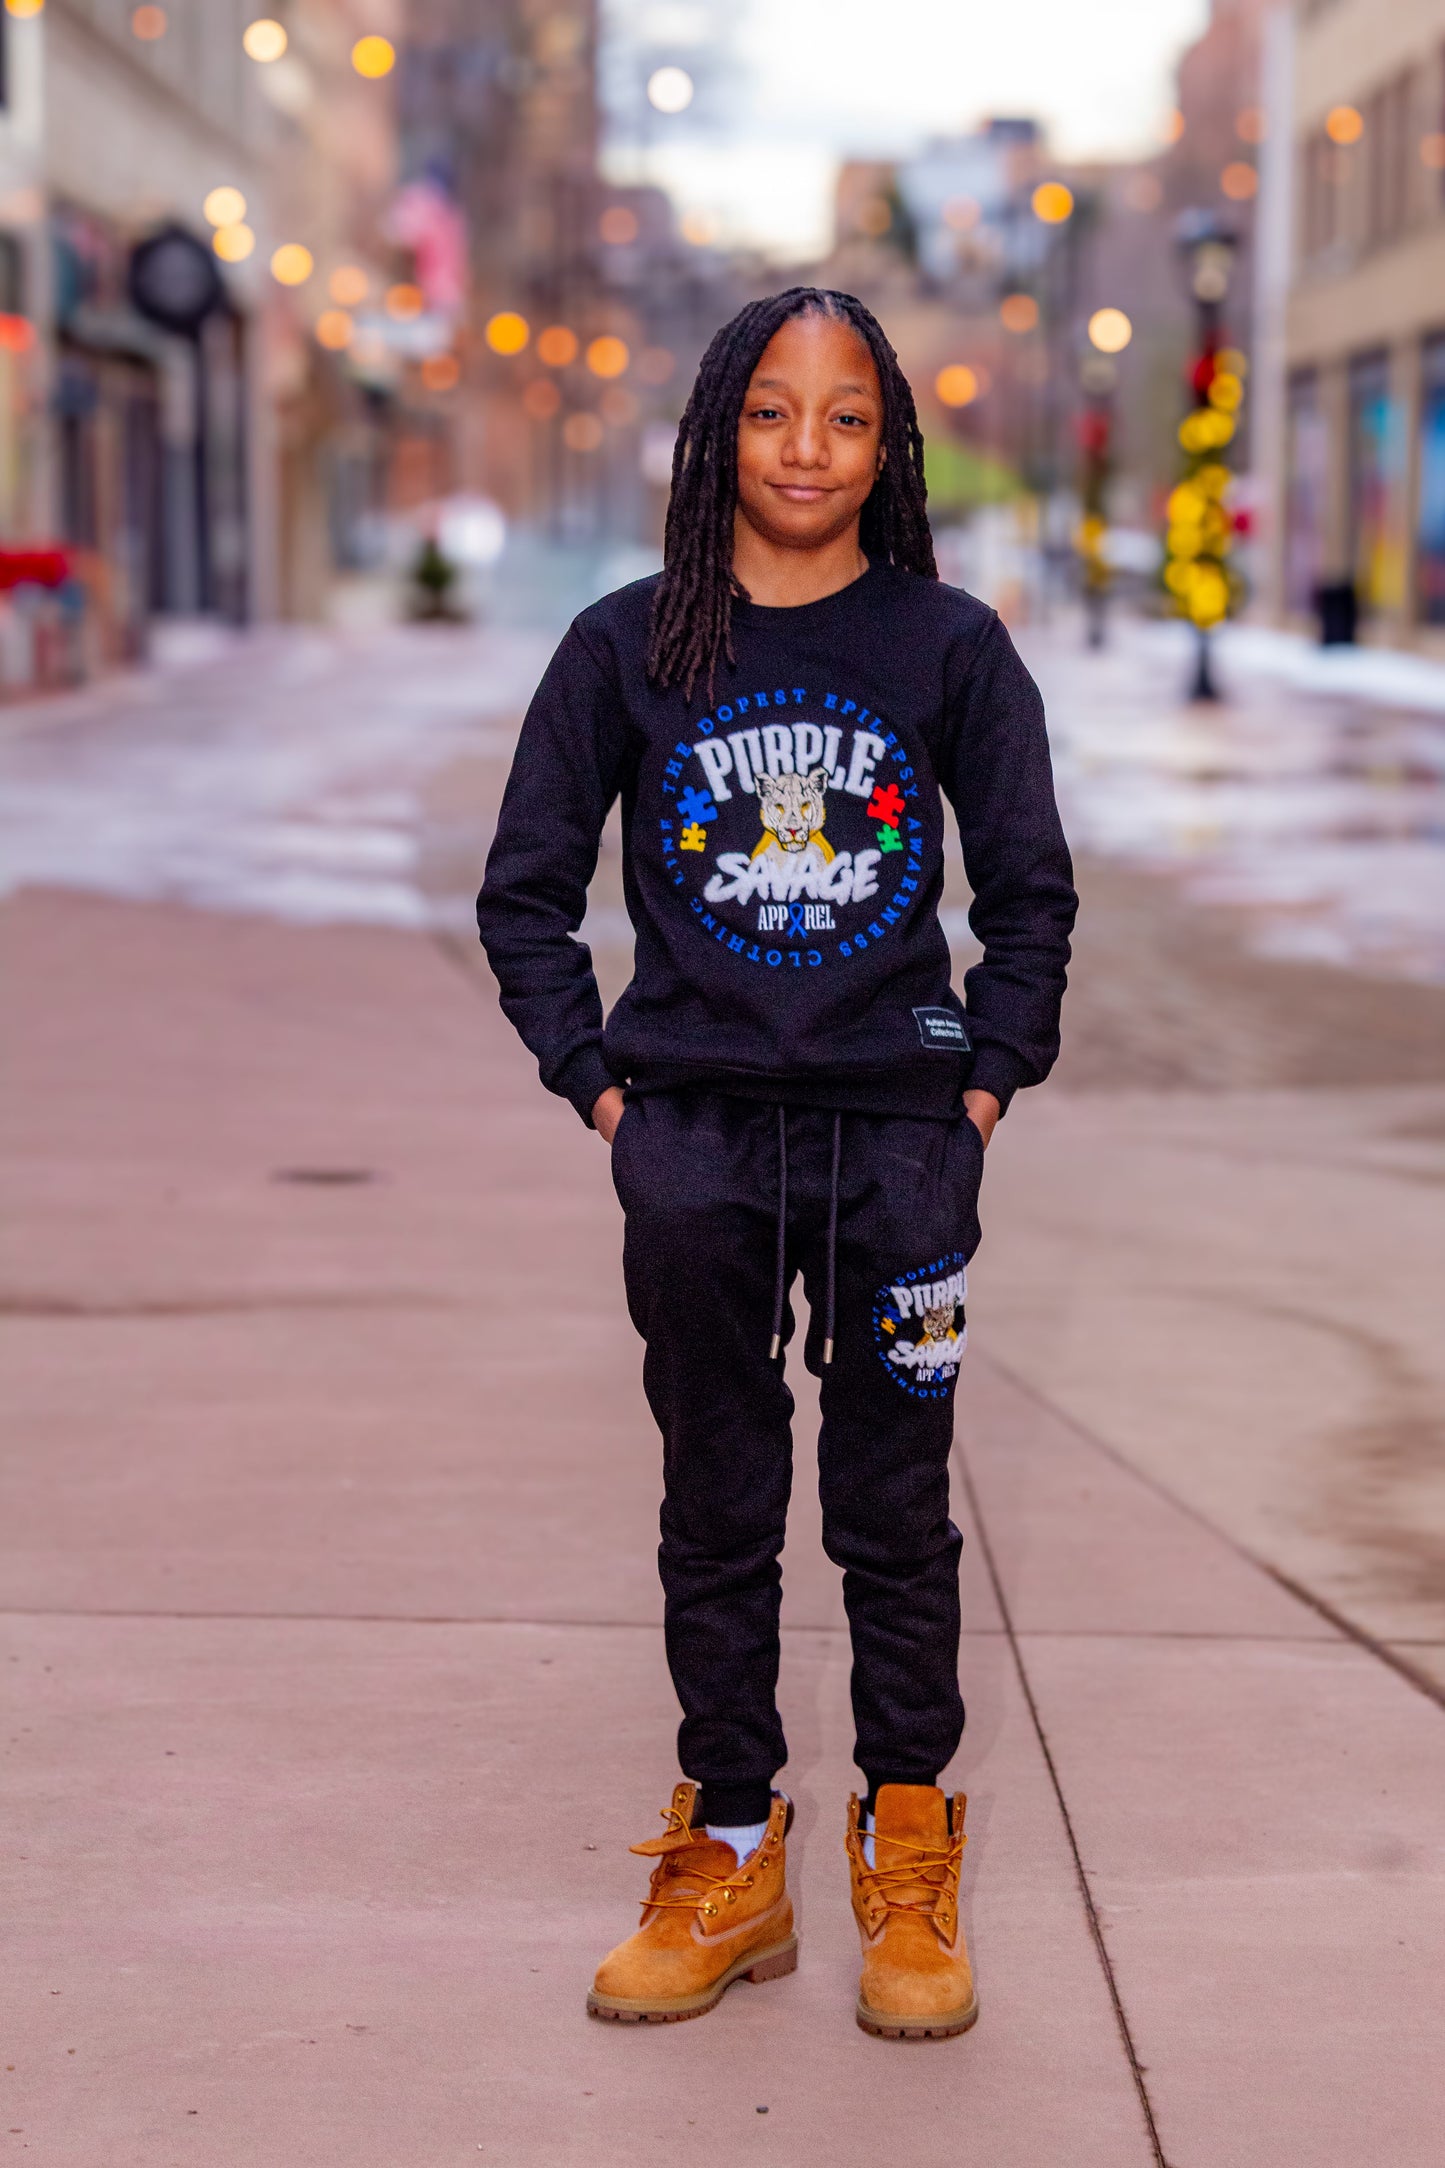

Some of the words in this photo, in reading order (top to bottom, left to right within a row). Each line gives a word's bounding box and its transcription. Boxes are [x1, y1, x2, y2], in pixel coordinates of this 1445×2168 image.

[697, 688, 806, 736] DOPEST
[824, 693, 919, 798] EPILEPSY
[663, 741, 692, 795] THE
[693, 721, 887, 803] PURPLE
[660, 819, 685, 886] LINE
[704, 848, 882, 907] SAVAGE
[838, 816, 922, 957] AWARENESS
[689, 897, 823, 968] CLOTHING
